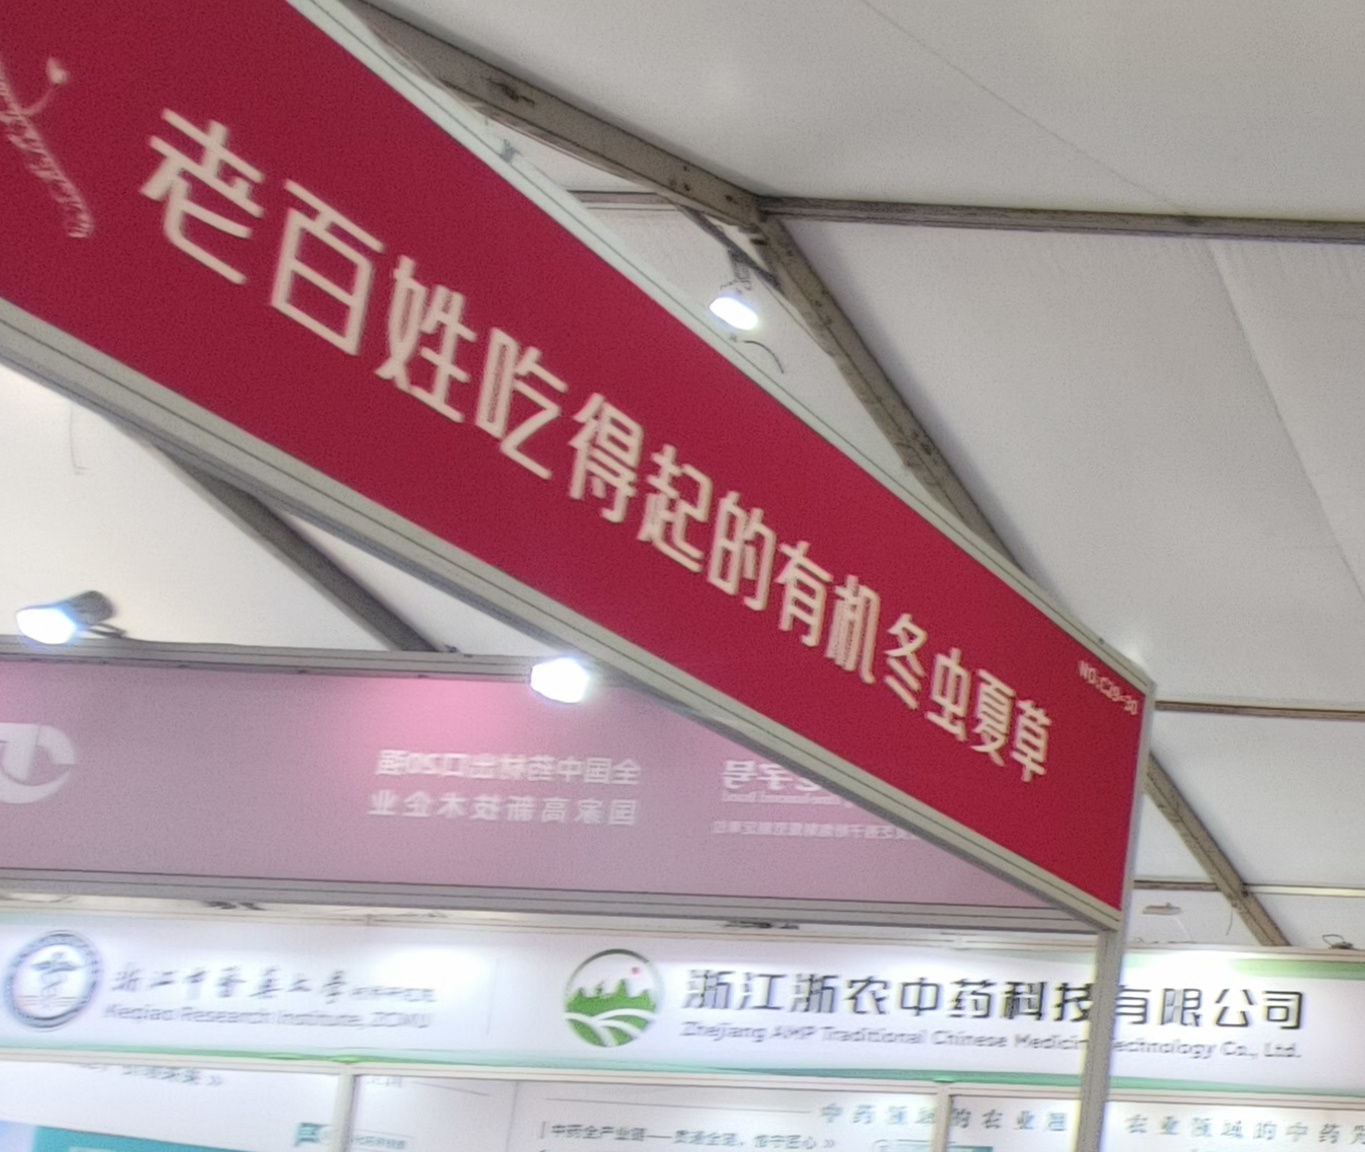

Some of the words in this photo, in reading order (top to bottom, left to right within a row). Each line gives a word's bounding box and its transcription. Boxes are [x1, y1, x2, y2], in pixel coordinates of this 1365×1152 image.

[140, 107, 1052, 784] 老百姓吃得起的有机冬虫夏草
[682, 968, 1305, 1030] 浙江浙农中药科技有限公司
[680, 1020, 767, 1043] Zhejiang
[820, 1026, 927, 1047] Traditional
[935, 1030, 1008, 1049] Chinese
[1013, 1034, 1089, 1052] Medicin
[1108, 1037, 1216, 1060] echnology
[1263, 1043, 1303, 1060] Ltd.
